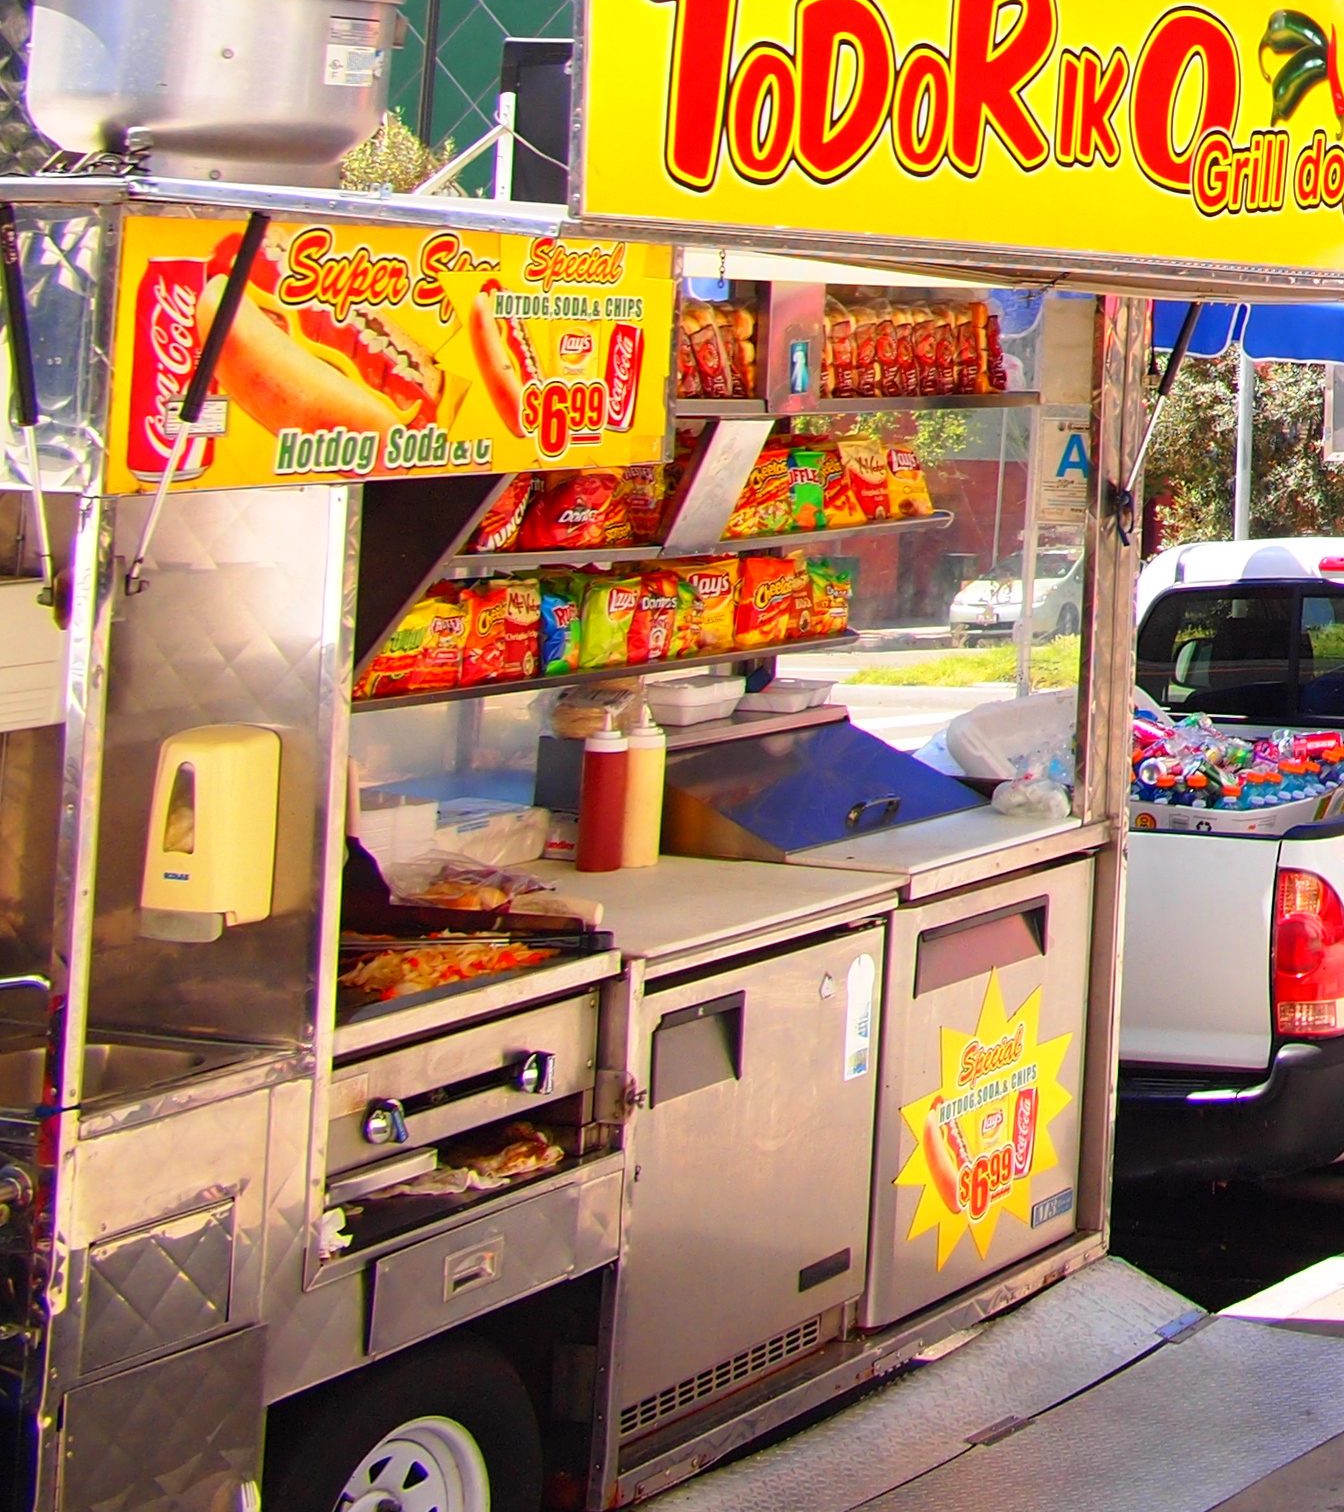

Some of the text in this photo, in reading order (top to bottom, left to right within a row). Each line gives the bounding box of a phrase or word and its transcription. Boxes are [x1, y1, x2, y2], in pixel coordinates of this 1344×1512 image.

[1193, 128, 1285, 217] Grill
[279, 228, 410, 323] Super
[525, 236, 626, 293] Special
[605, 298, 643, 319] CHIPS
[276, 427, 378, 474] Hotdog
[387, 425, 448, 469] Soda
[452, 438, 469, 463] &
[1056, 433, 1090, 479] A
[755, 575, 793, 608] Cheeto
[957, 1023, 1024, 1088] Special
[1011, 1065, 1037, 1090] CHIPS
